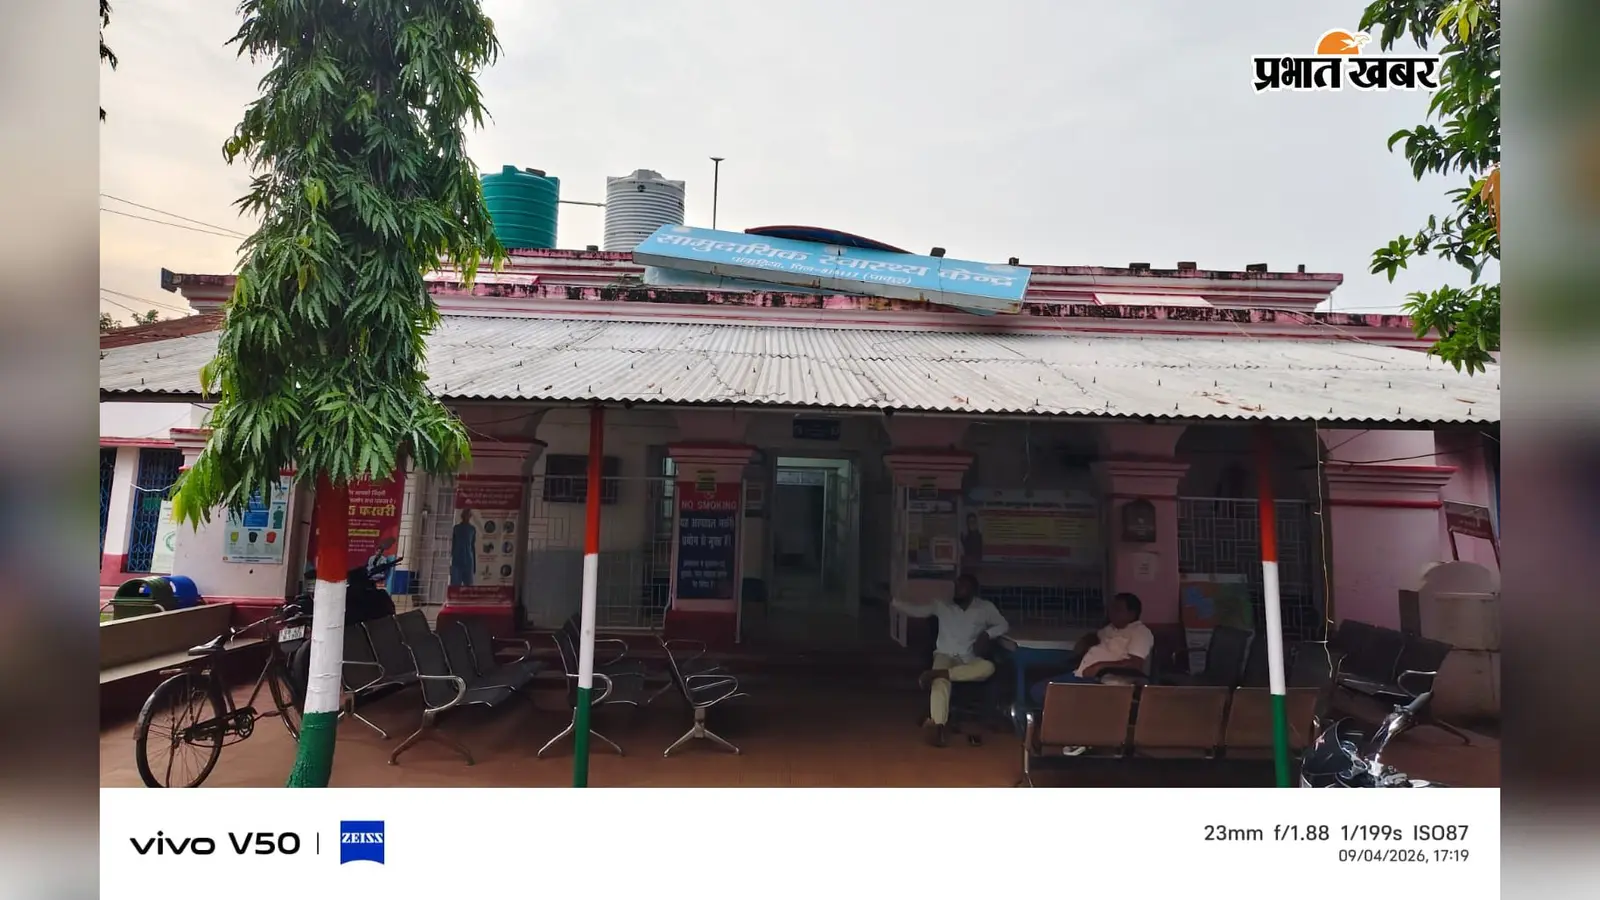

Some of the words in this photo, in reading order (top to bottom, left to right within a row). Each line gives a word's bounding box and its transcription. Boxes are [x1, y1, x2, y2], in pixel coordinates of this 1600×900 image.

[656, 233, 813, 262] सामुदायिक
[819, 252, 931, 277] स्वास्थ्य
[359, 504, 396, 517] फरवरी
[681, 500, 694, 510] NO
[697, 499, 737, 510] SMOKING
